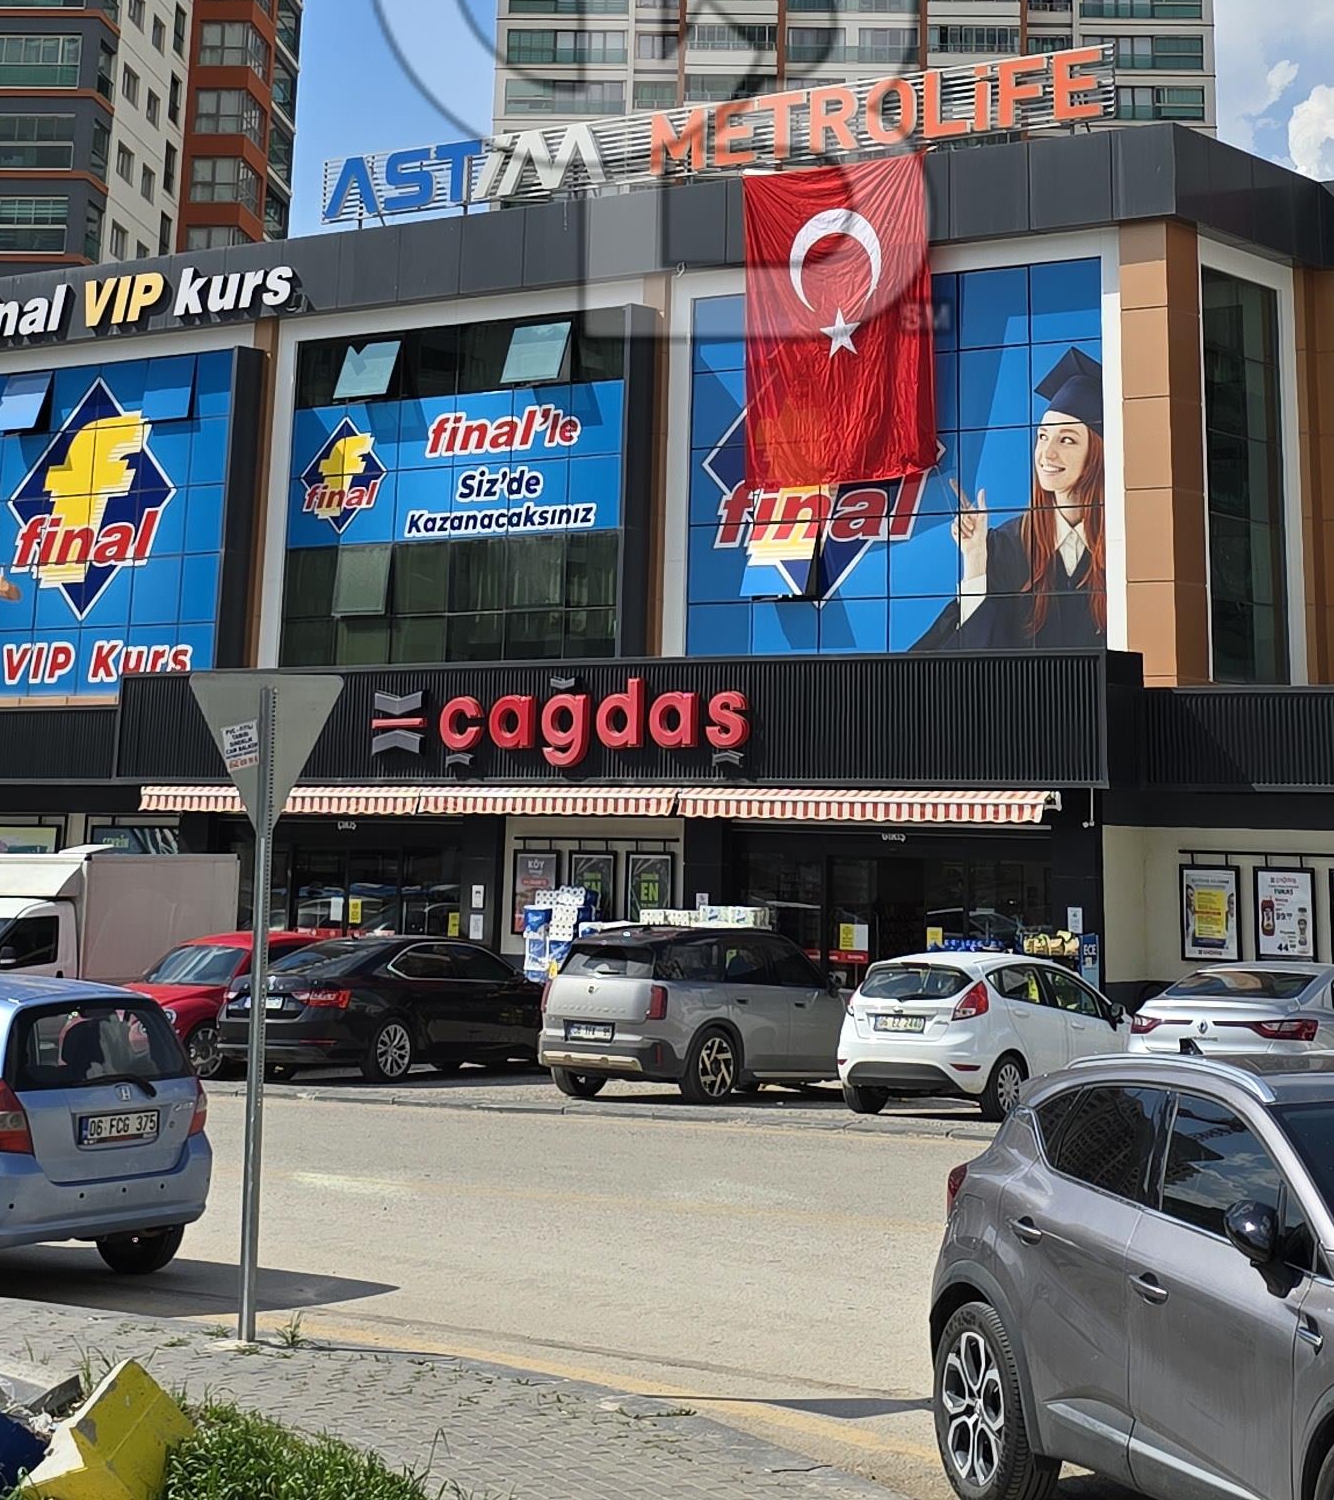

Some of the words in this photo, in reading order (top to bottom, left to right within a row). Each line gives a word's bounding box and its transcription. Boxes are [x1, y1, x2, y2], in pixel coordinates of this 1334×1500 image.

[84, 271, 164, 328] VIP
[173, 266, 295, 317] kurs
[426, 406, 580, 458] final'le
[303, 478, 379, 512] final
[458, 468, 542, 502] Siz'de
[405, 504, 596, 537] Kazanacaksınız
[714, 470, 930, 549] final
[11, 507, 161, 573] final
[4, 642, 74, 684] VIP
[88, 640, 192, 682] Kurs
[640, 882, 659, 900] EN
[89, 1119, 104, 1137] 06
[136, 1113, 156, 1132] 375
